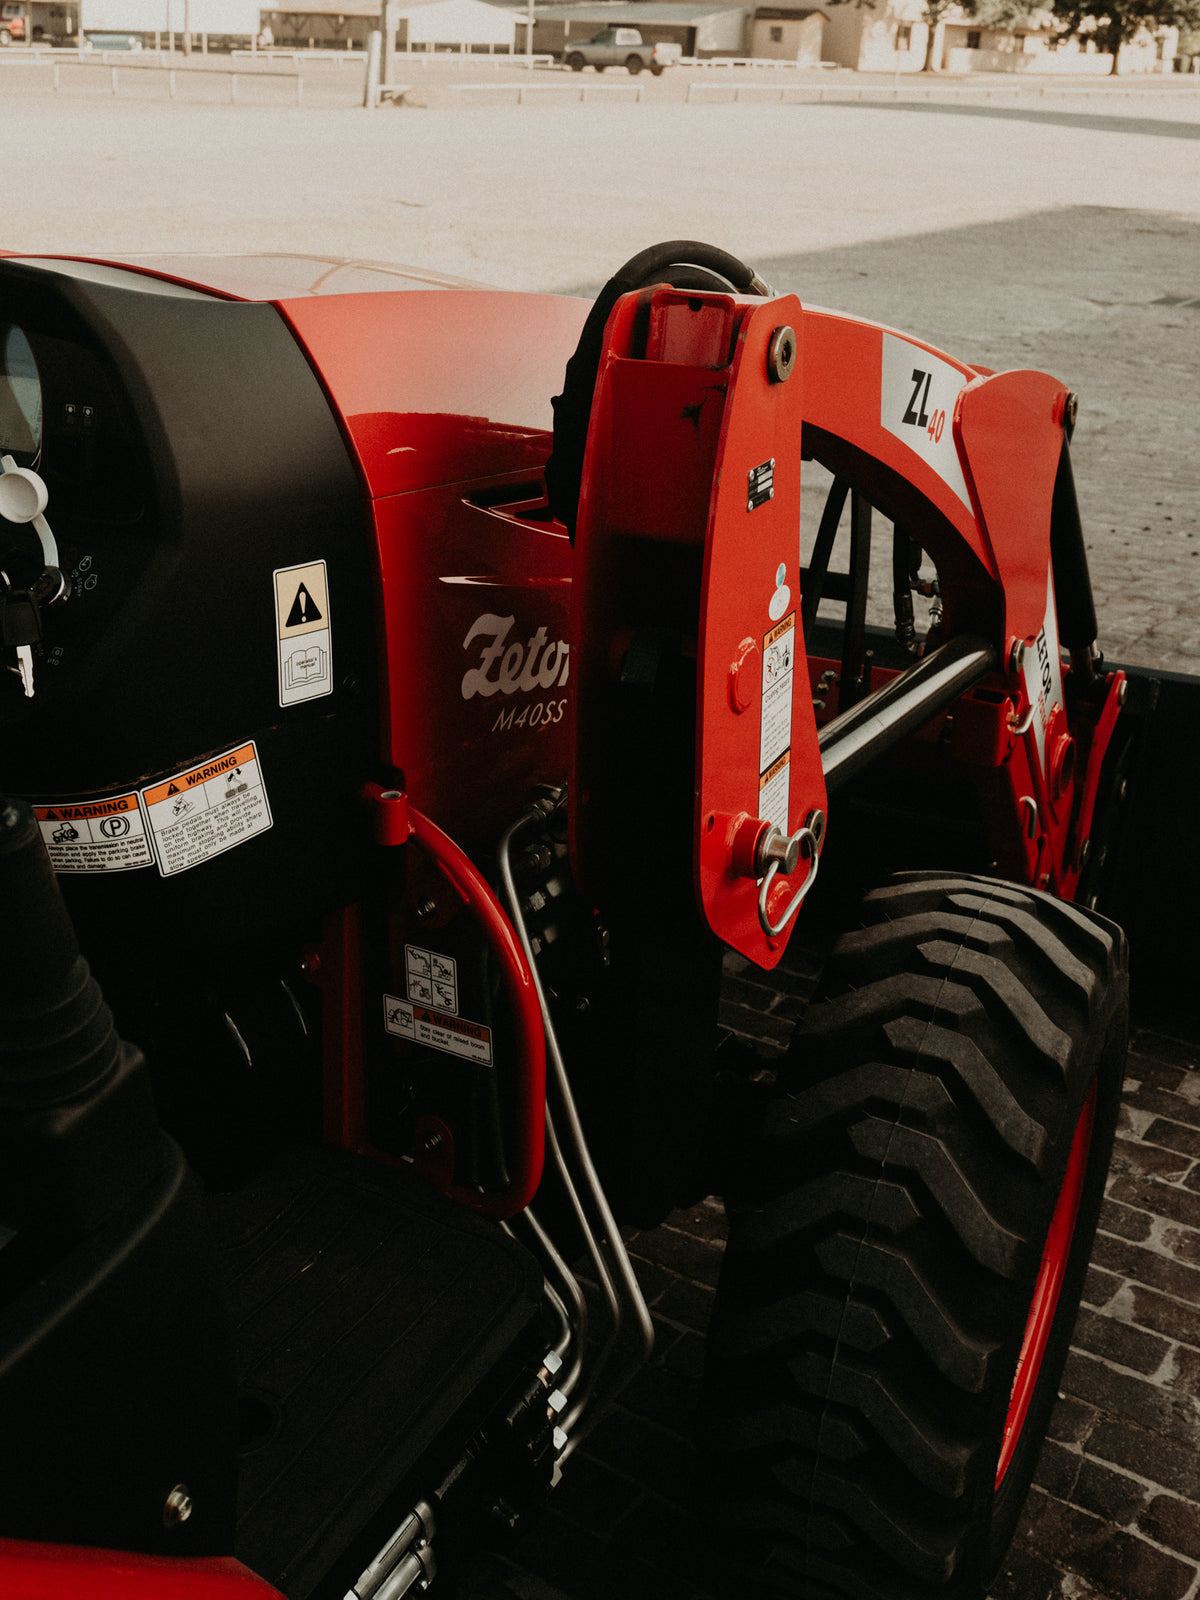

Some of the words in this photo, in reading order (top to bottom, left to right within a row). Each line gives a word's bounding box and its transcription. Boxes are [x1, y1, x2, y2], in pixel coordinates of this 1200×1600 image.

[902, 368, 932, 428] ZL
[927, 408, 945, 443] 40
[774, 618, 792, 637] WARNING
[461, 613, 569, 700] Zetor
[1036, 624, 1052, 702] ZETOR
[492, 699, 567, 732] M40SS
[185, 756, 237, 786] WARNING
[769, 756, 787, 778] WARNING
[60, 800, 129, 819] WARNING
[161, 826, 179, 837] Brake
[181, 815, 203, 828] pedals
[204, 807, 219, 817] must
[221, 797, 240, 810] always
[242, 791, 251, 799] be
[174, 836, 185, 845] the
[187, 824, 215, 839] highway.
[217, 816, 230, 825] This
[231, 809, 242, 817] will
[243, 799, 263, 812] ensure
[162, 830, 184, 842] locked
[185, 818, 212, 833] together
[214, 809, 229, 819] when
[165, 841, 189, 854] uniform
[191, 830, 215, 843] braking
[216, 822, 228, 832] and
[230, 811, 252, 825] provide
[167, 845, 196, 859] maximum
[198, 831, 225, 847] stopping
[226, 822, 244, 833] ability
[246, 812, 263, 823] sharp
[89, 842, 120, 851] transmission
[127, 837, 144, 846] neutral
[109, 846, 129, 855] parking
[130, 843, 145, 851] brake
[122, 852, 132, 860] can
[132, 850, 147, 858] cause
[168, 856, 185, 866] turns
[187, 848, 202, 858] must
[204, 841, 217, 850] only
[229, 827, 245, 837] made
[170, 862, 184, 871] slow
[187, 851, 209, 865] speeds
[420, 1032, 431, 1040] and
[420, 1024, 431, 1034] Stay
[432, 1028, 445, 1039] clear
[446, 1032, 452, 1040] of
[453, 1035, 469, 1046] raised
[470, 1041, 485, 1051] boom
[432, 1014, 482, 1038] WARNING
